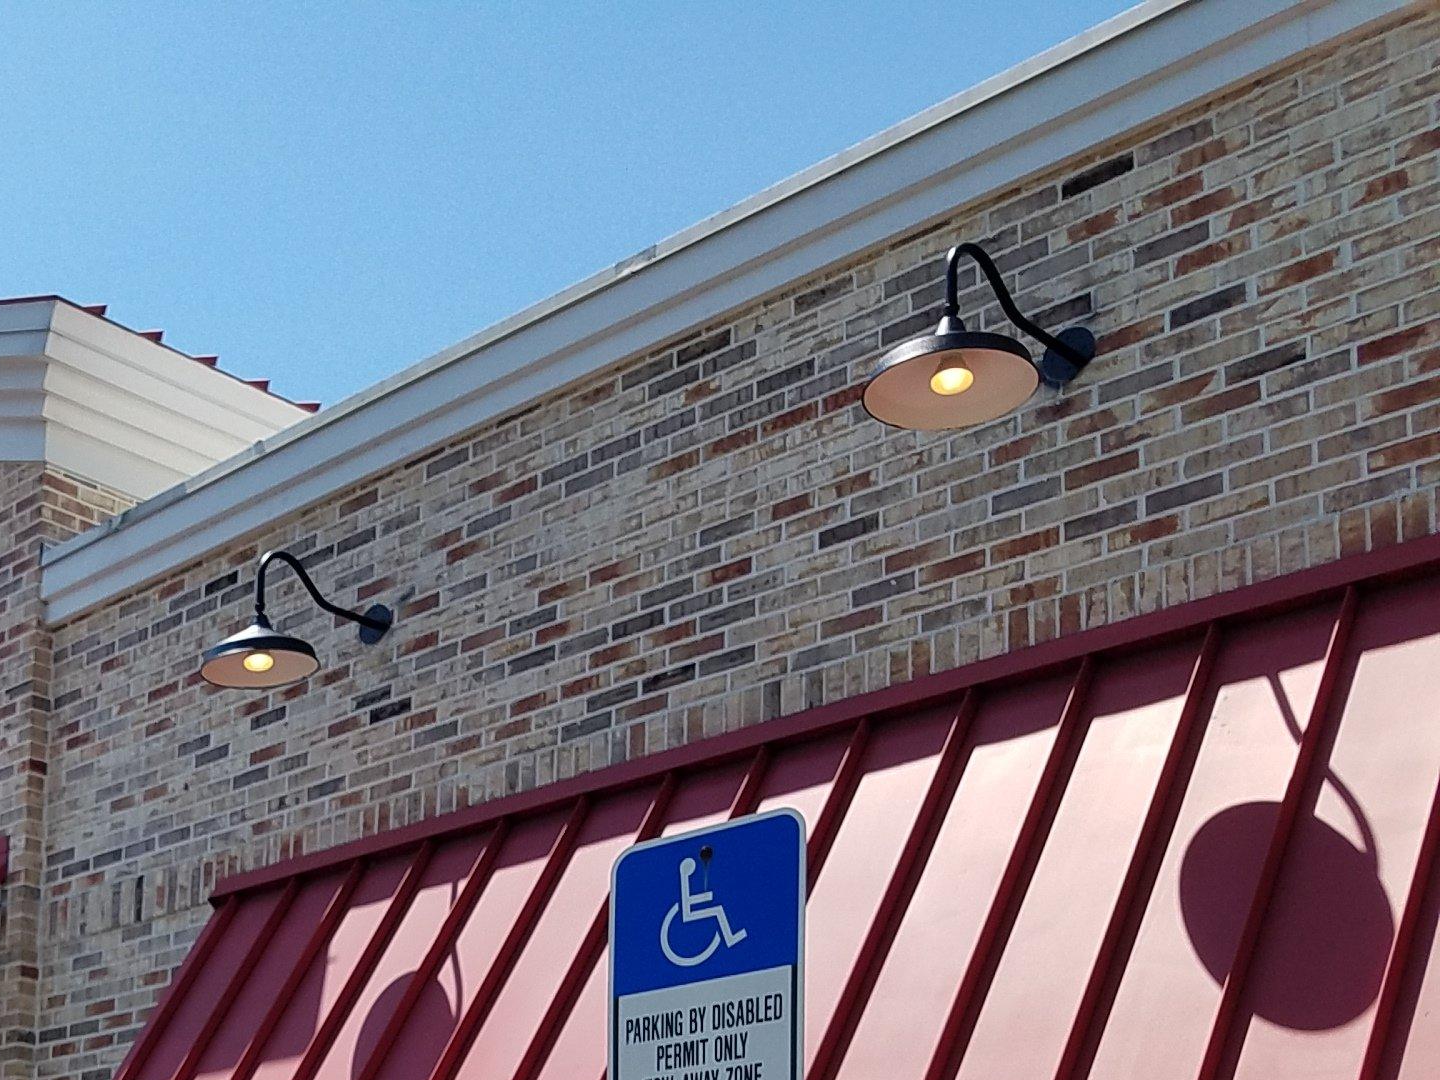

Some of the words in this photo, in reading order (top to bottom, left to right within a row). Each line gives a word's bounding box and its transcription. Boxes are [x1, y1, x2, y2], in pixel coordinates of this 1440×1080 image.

[626, 1011, 683, 1045] PARKING
[689, 1007, 706, 1033] BY
[712, 993, 783, 1028] DISABLED
[656, 1038, 709, 1072] PERMIT
[714, 1031, 749, 1062] ONLY
